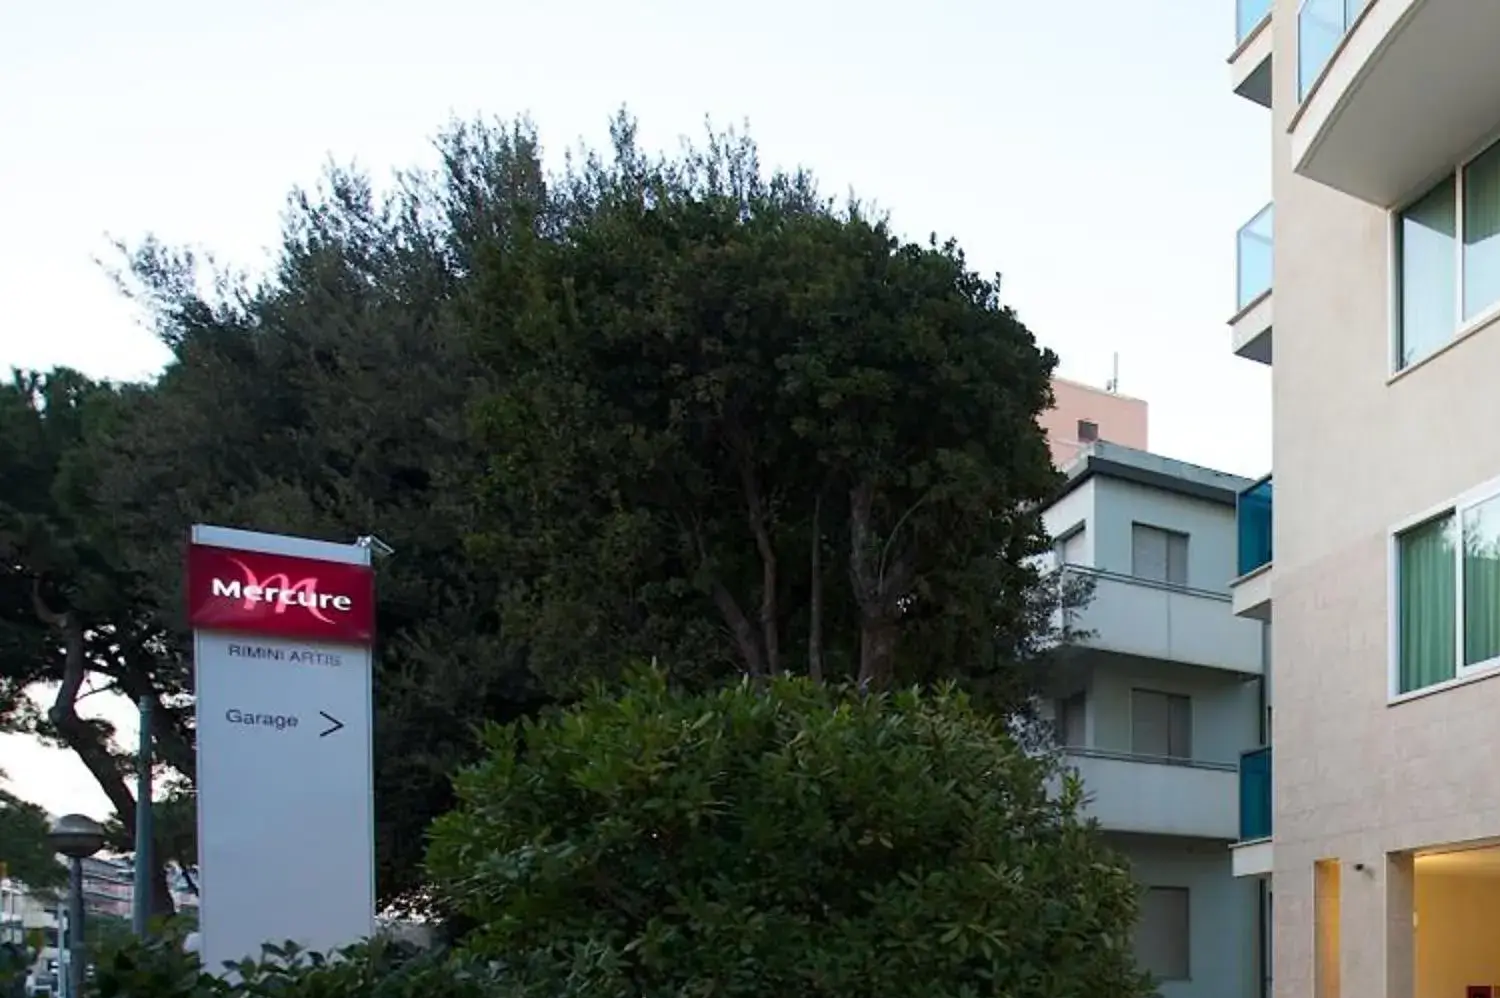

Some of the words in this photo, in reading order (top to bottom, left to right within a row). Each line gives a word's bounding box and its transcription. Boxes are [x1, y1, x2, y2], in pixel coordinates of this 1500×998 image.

[211, 577, 352, 611] Mercure
[228, 643, 285, 661] RIMINI
[289, 649, 343, 668] ARTIS
[225, 708, 299, 730] Garage
